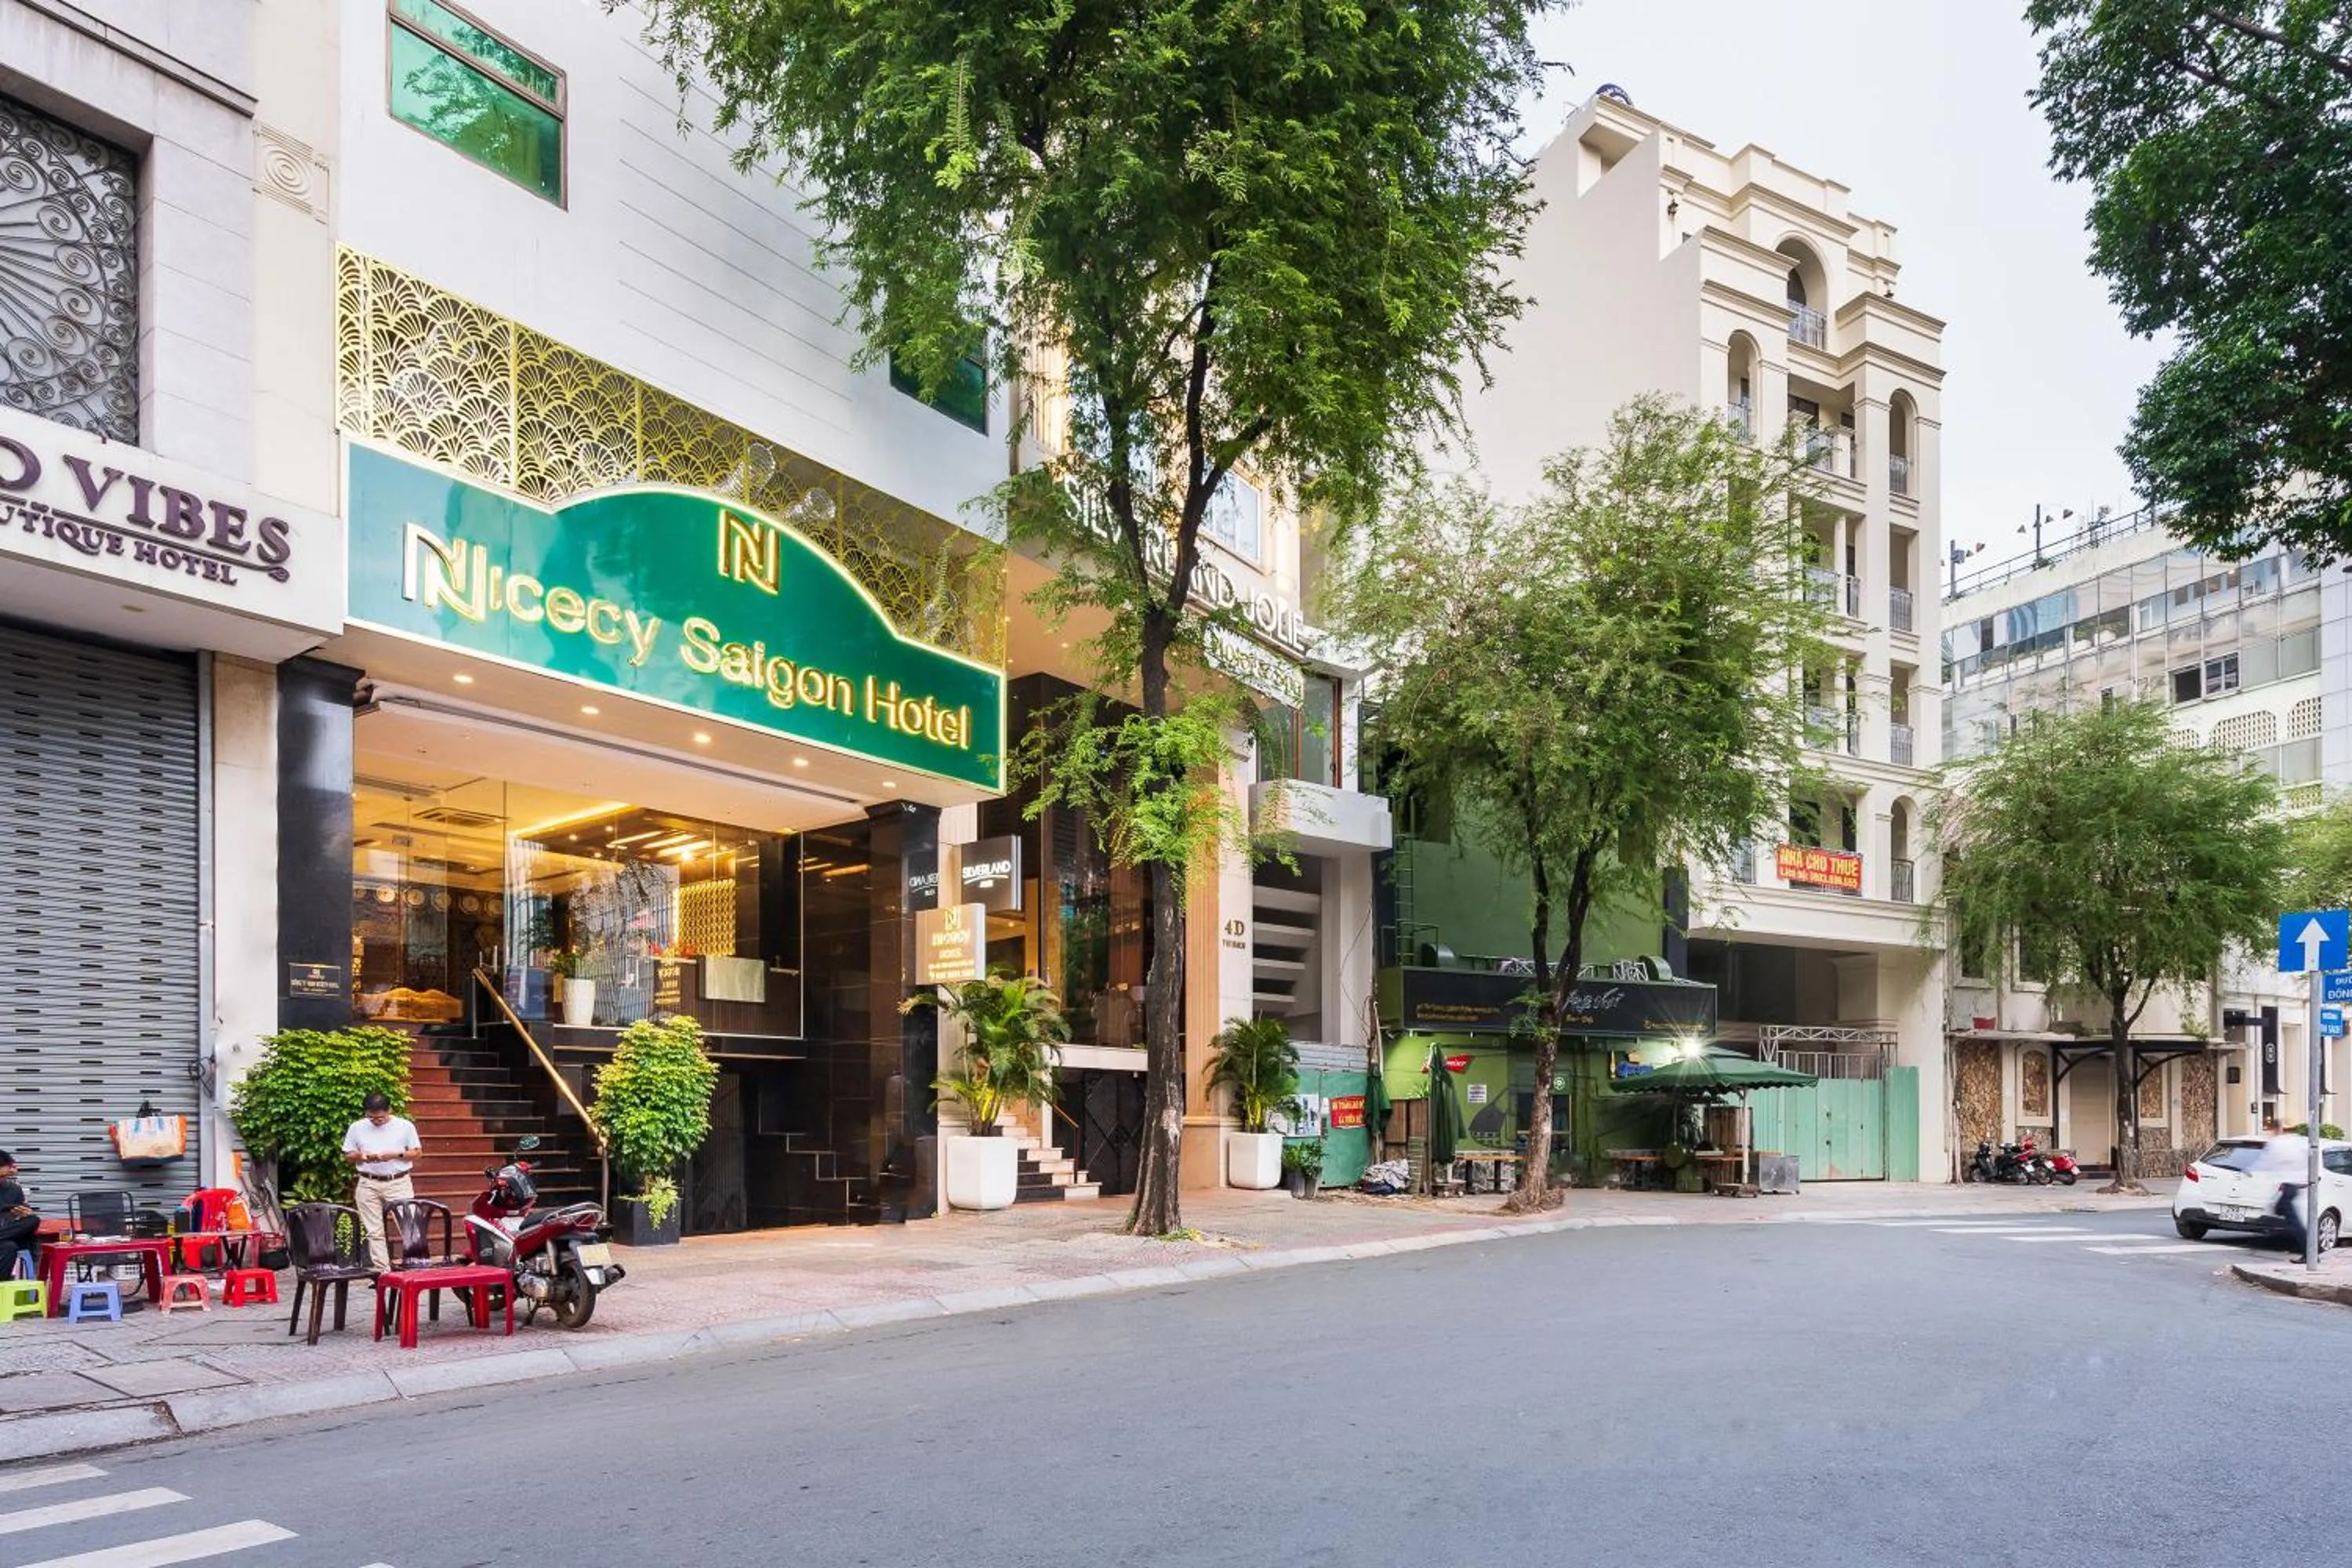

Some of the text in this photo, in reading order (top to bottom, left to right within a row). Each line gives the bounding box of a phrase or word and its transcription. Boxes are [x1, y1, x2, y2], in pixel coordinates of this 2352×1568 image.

[62, 453, 292, 564] VIBES
[134, 541, 238, 586] HOTEL
[1241, 586, 1306, 653] JOLIE
[679, 616, 855, 716] Saigon
[865, 674, 972, 750] Hotel
[962, 860, 1011, 878] SILVERLAND
[1224, 919, 1245, 937] 4D
[2328, 988, 2352, 999] ĐÔN
